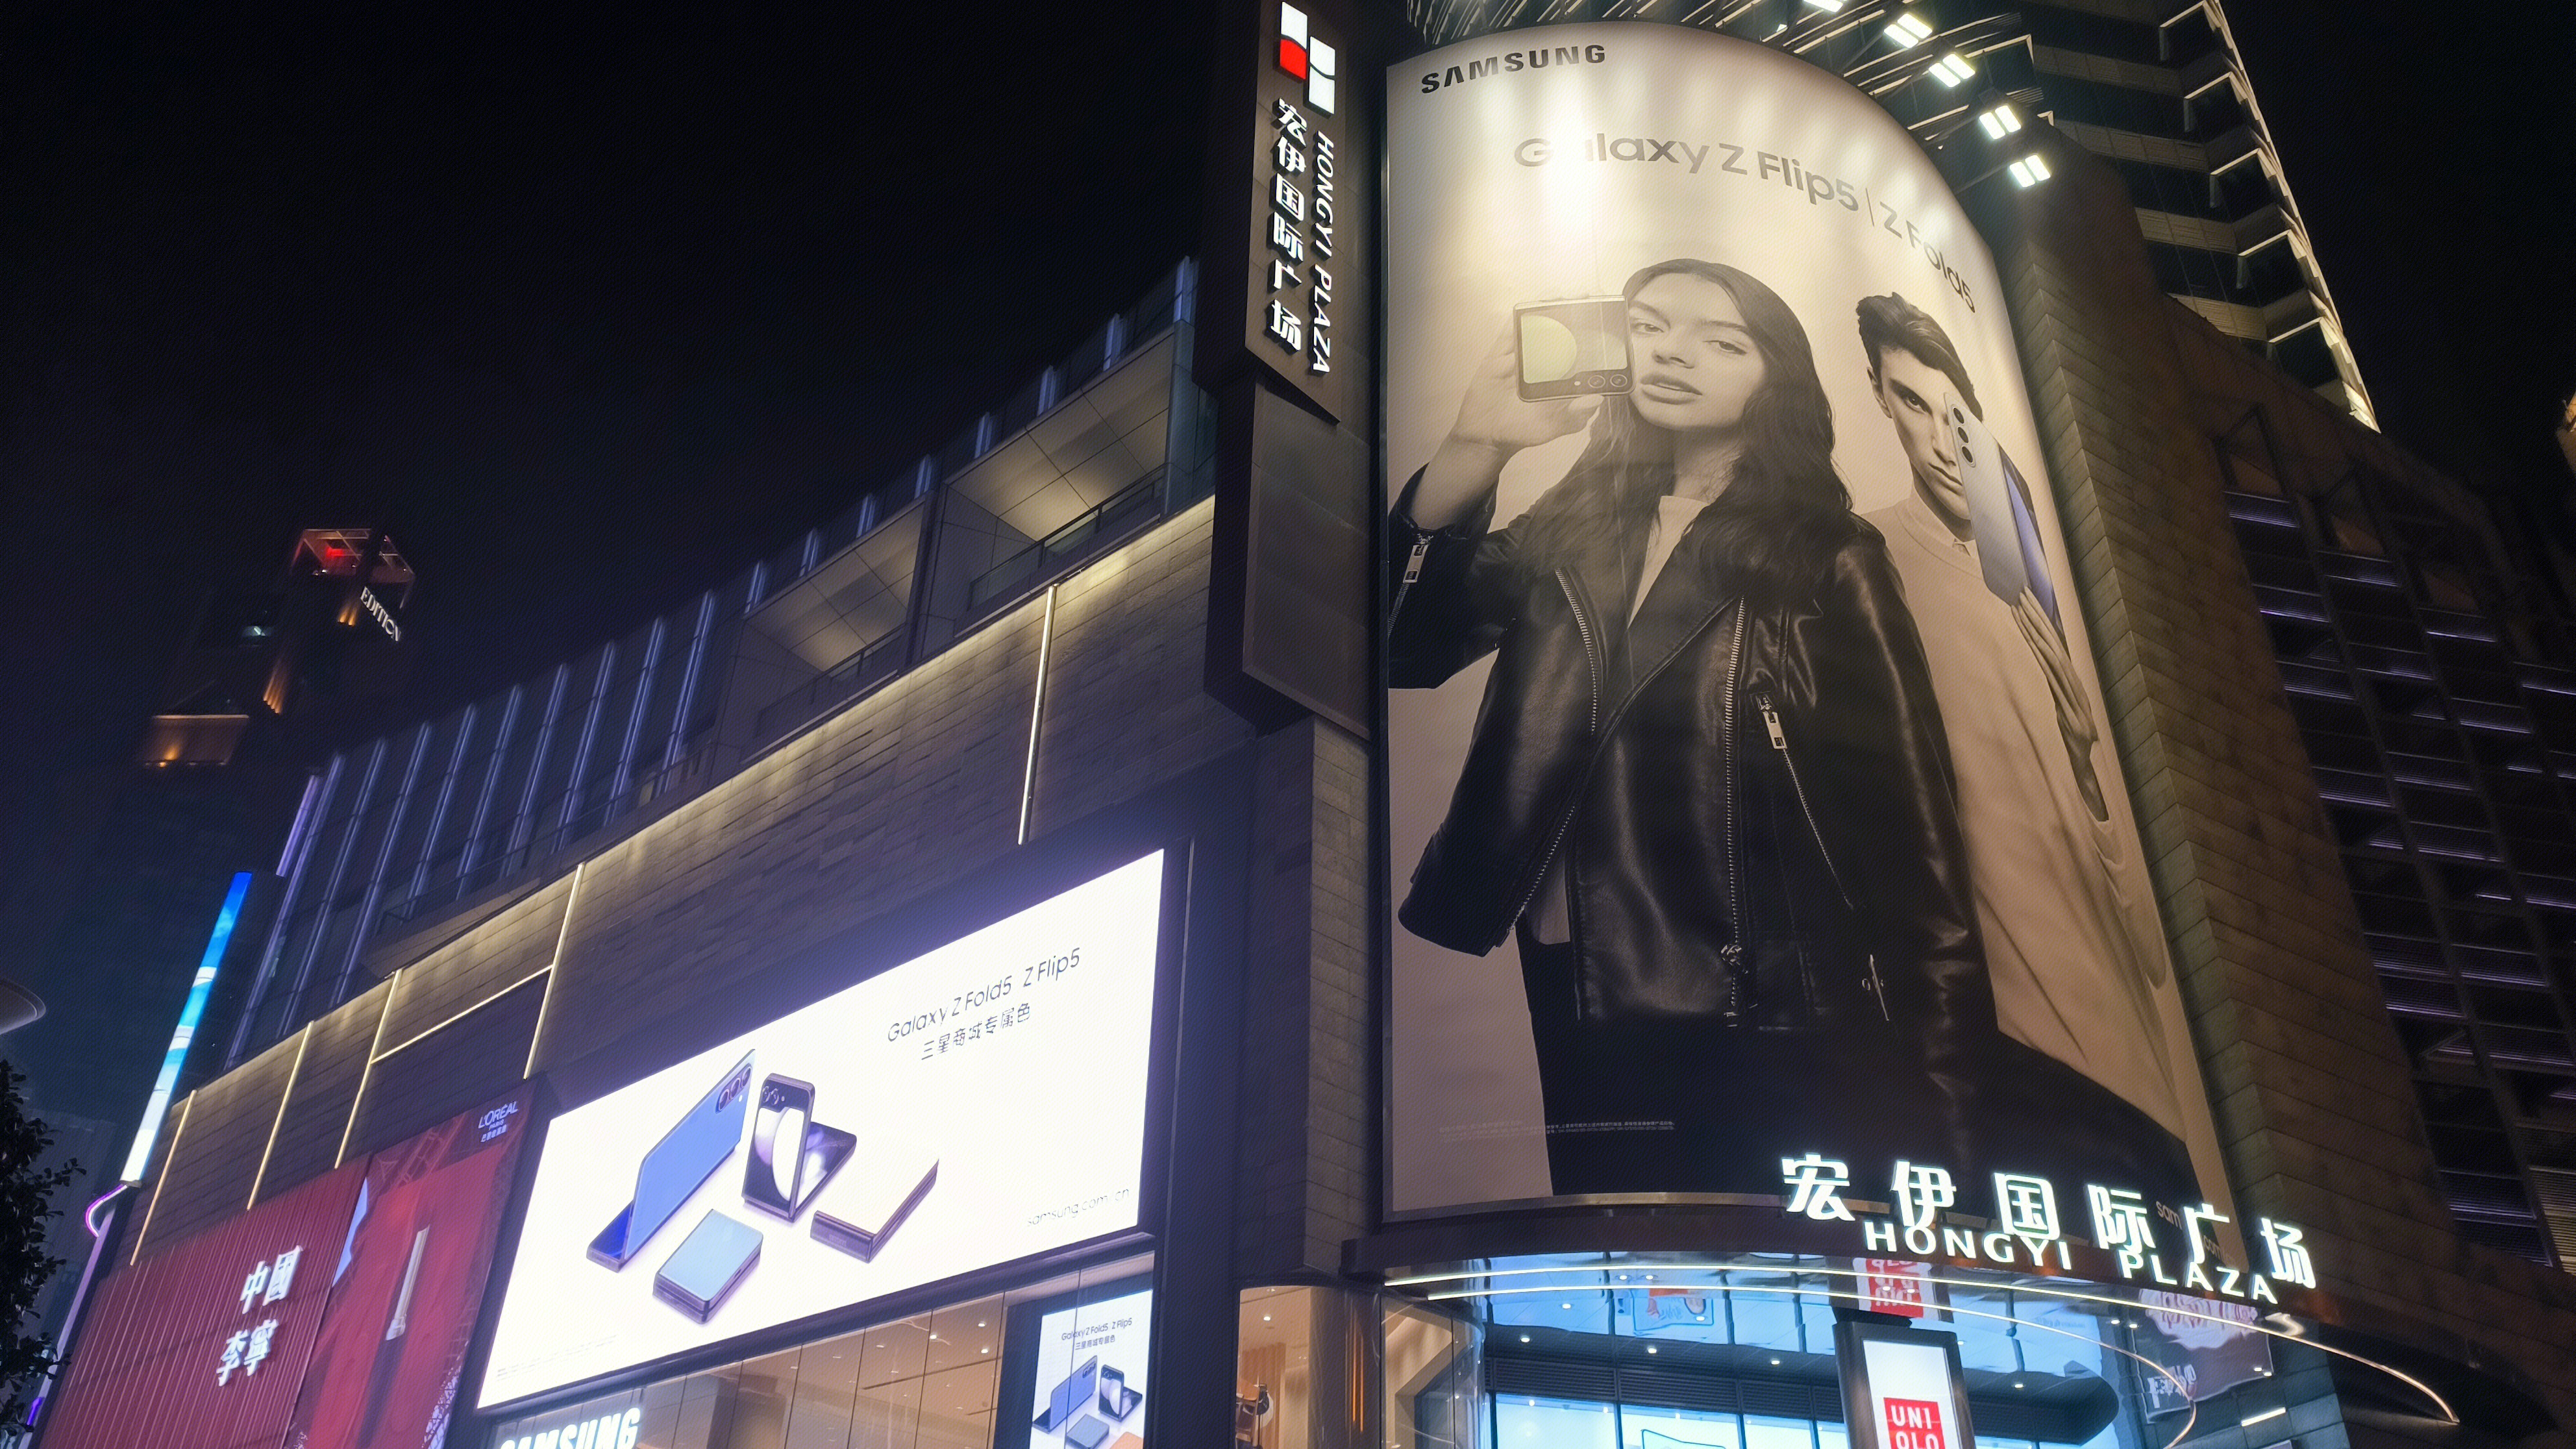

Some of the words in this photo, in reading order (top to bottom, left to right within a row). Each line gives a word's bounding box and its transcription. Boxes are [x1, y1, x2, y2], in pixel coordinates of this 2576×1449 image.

[1421, 44, 1607, 94] SAMSUNG
[1270, 97, 1307, 352] 宏伊国际广场
[1315, 130, 1334, 258] HONGYI
[1719, 142, 1748, 175] Z
[1757, 151, 1859, 212] Flip5
[1879, 201, 1903, 240] Z
[1906, 219, 1975, 314] Fold5
[1313, 264, 1332, 373] PLAZA
[360, 586, 401, 642] EDITION
[887, 1007, 948, 1042] Galaxy
[952, 997, 961, 1017] Z
[965, 975, 1012, 1011] Fold5
[1023, 967, 1034, 987] Z
[1037, 947, 1080, 981] Flip5
[921, 1002, 1031, 1060] 三星商城专属色
[1027, 1188, 1130, 1227] samsungcom/cn
[1781, 1152, 2316, 1289] 宏伊国际广场
[240, 1245, 303, 1315] 中國
[1864, 1220, 2072, 1270] HONGYI
[2121, 1252, 2278, 1305] PLAZA
[216, 1318, 279, 1387] 李寧
[500, 1407, 641, 1449] SUNG
[1890, 1404, 1933, 1430] UNI
